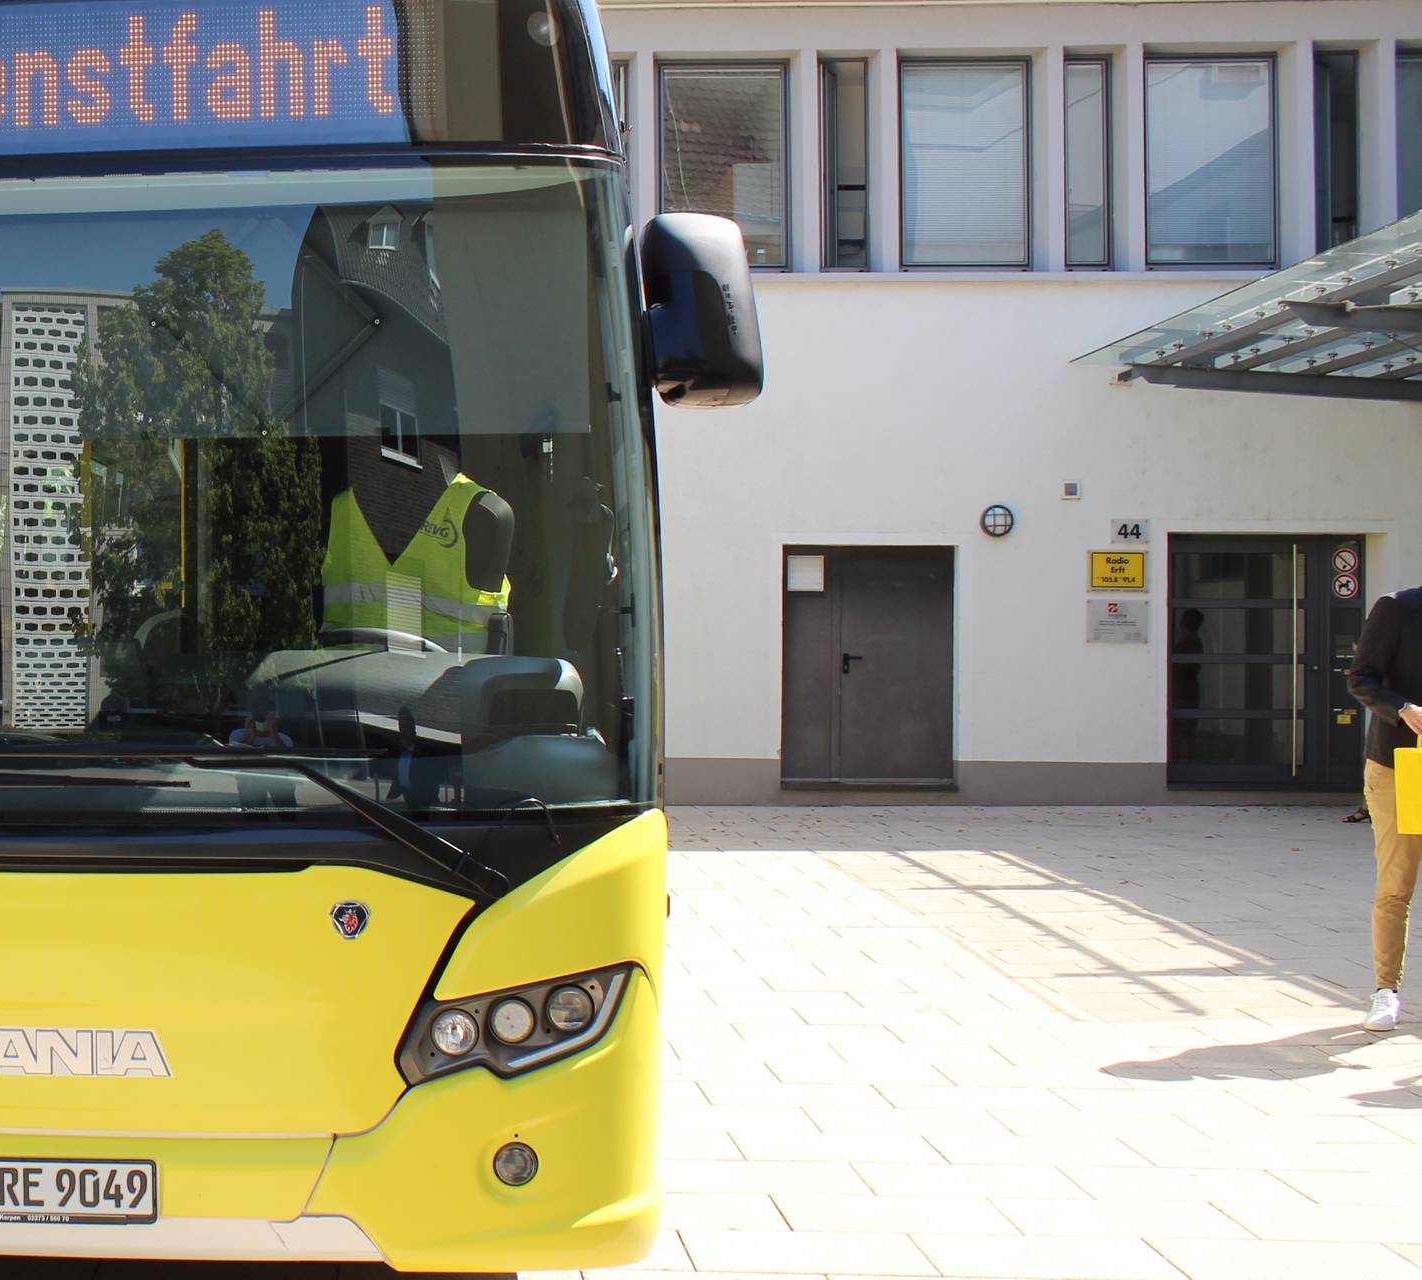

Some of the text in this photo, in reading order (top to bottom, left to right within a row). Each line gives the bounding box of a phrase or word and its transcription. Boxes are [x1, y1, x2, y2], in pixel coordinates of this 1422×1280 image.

[1117, 523, 1142, 539] 44
[1105, 556, 1130, 565] Radio
[1110, 566, 1126, 574] Erft
[54, 1168, 148, 1209] 9049
[0, 1213, 22, 1222] Kerpen
